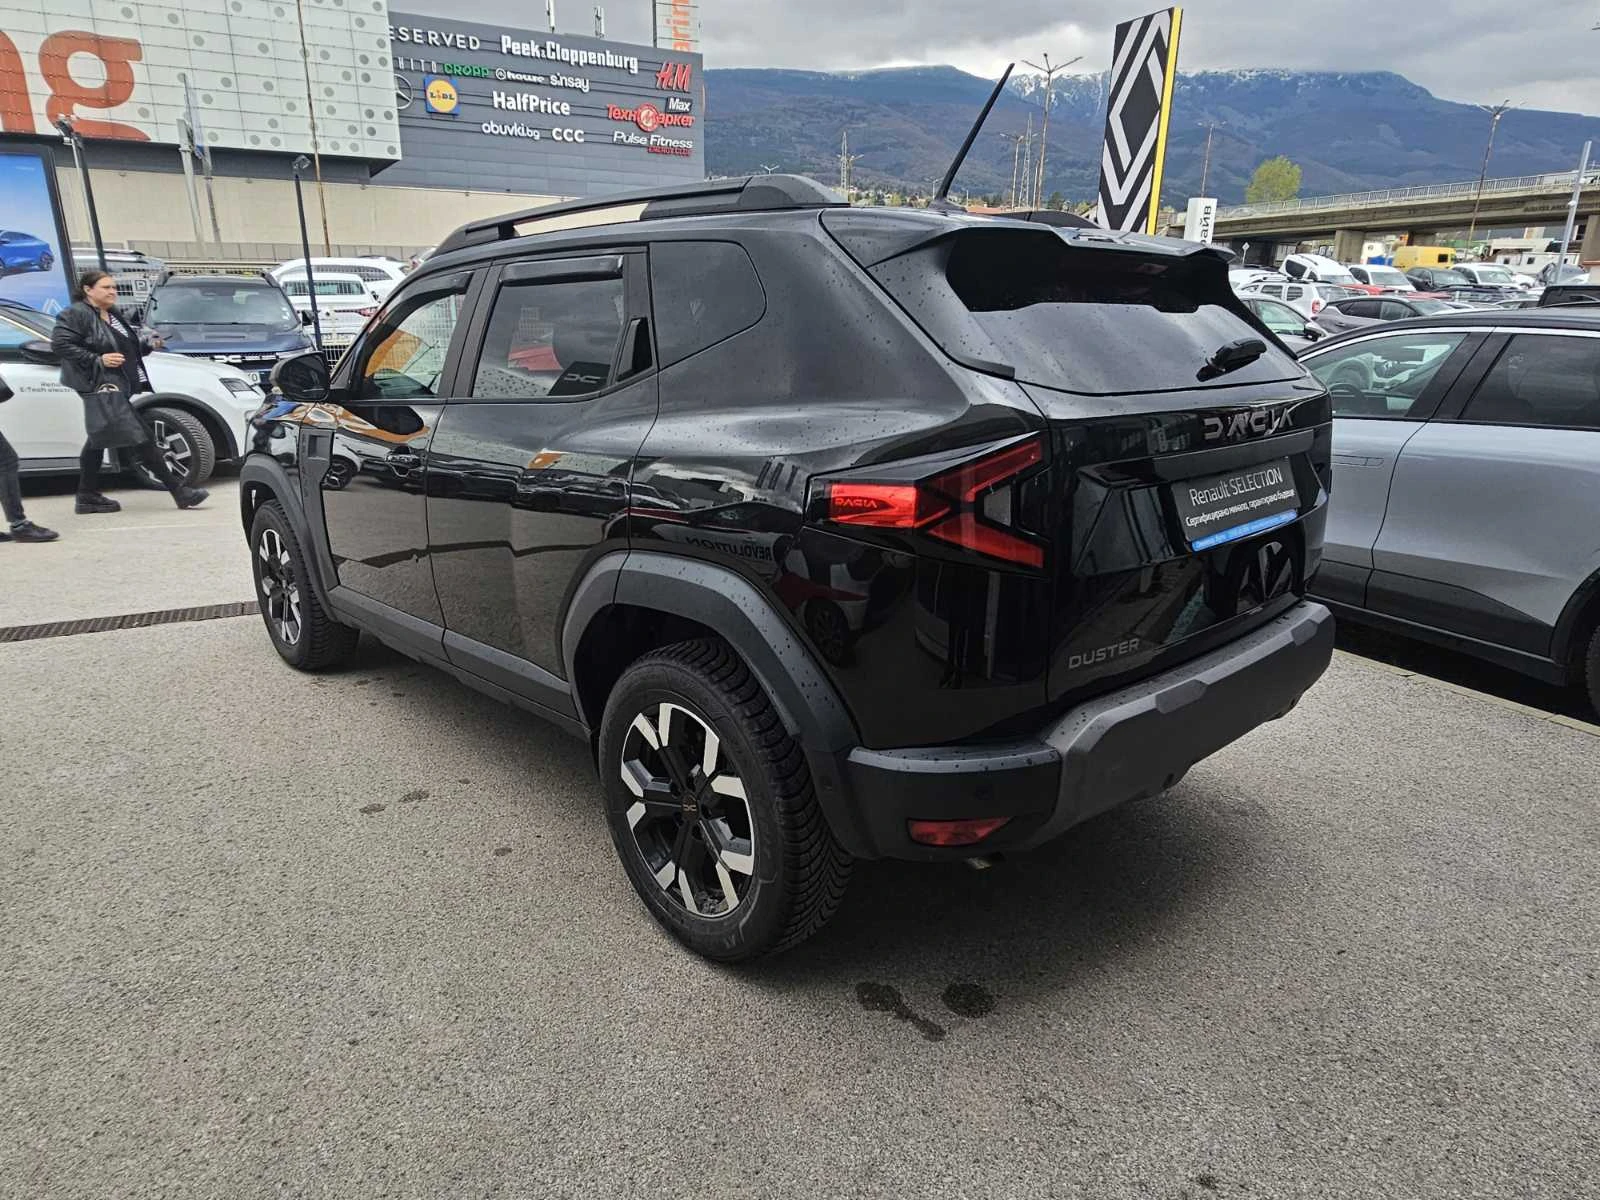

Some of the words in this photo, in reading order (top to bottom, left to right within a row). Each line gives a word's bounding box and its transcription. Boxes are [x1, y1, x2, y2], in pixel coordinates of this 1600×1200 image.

[443, 63, 489, 78] CROPP
[655, 61, 692, 93] H&M
[550, 73, 589, 93] sinsay
[492, 90, 570, 116] HalfPrice
[669, 97, 691, 112] Max
[482, 121, 540, 141] obuvki.bg
[552, 128, 585, 143] CCC
[613, 130, 648, 146] Pulse
[650, 134, 693, 149] Fitness
[1190, 480, 1231, 506] Renault
[1232, 468, 1283, 496] SELECTION
[834, 497, 878, 508] DACIA
[1069, 638, 1140, 669] DUSTER
